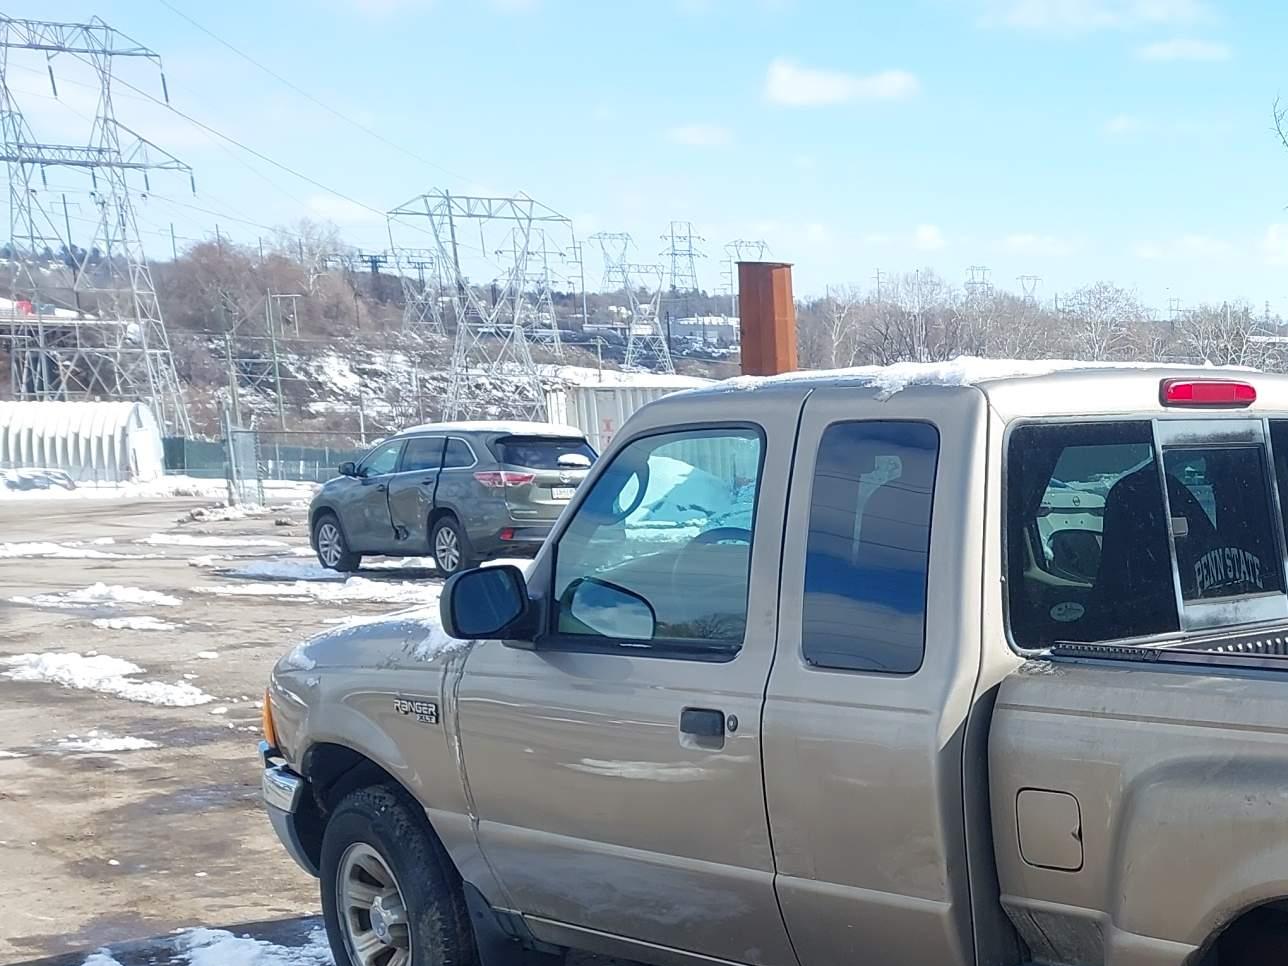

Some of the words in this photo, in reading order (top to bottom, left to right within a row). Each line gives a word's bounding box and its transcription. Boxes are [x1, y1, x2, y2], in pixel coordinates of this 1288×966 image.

[1194, 547, 1225, 597] PENN
[1225, 547, 1264, 590] STATE
[393, 699, 437, 716] RANGER
